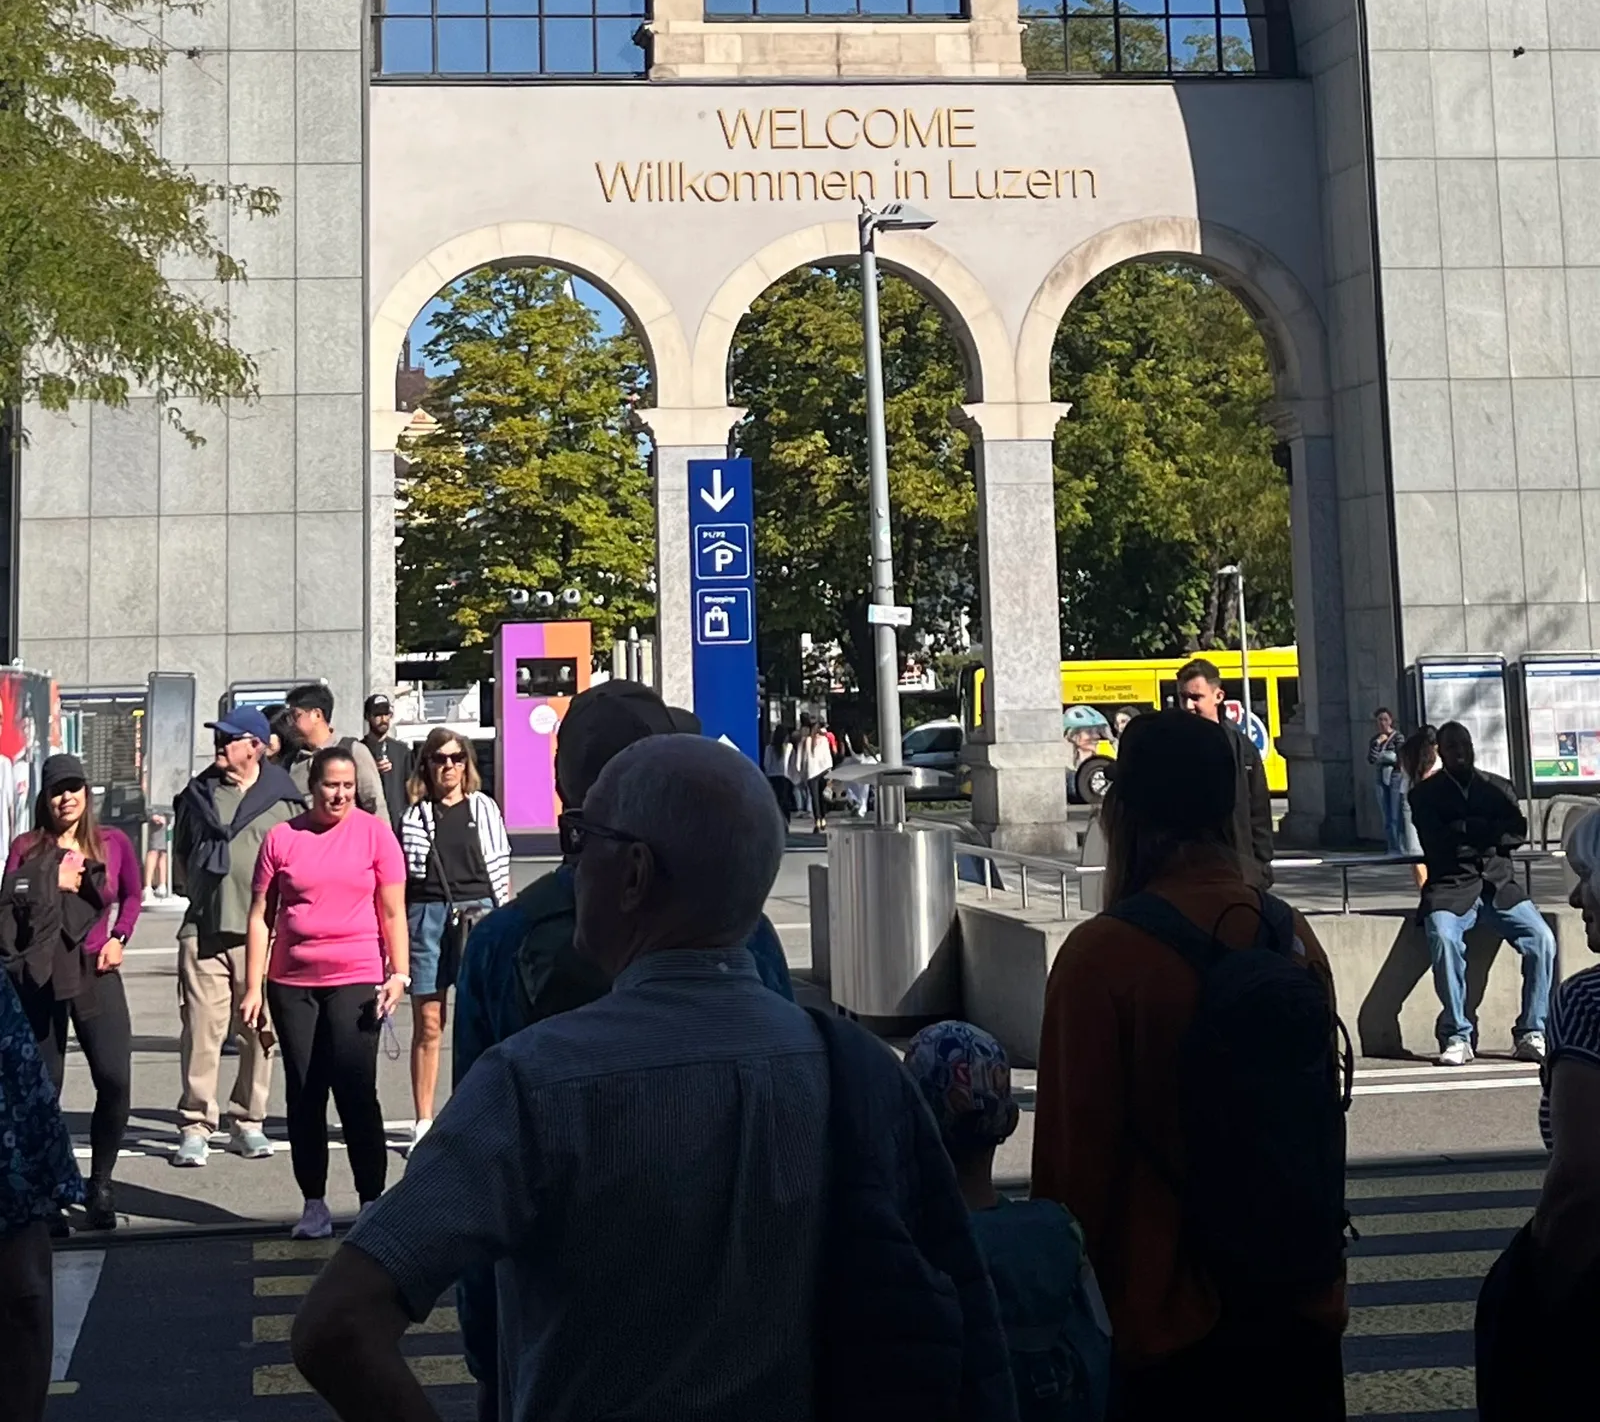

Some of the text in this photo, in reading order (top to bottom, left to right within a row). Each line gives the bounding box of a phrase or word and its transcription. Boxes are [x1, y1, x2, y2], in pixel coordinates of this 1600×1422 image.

[717, 108, 977, 149] WELCOME
[595, 158, 1098, 202] Willkommen in Luzern
[715, 548, 734, 572] P
[704, 596, 736, 604] Shopping
